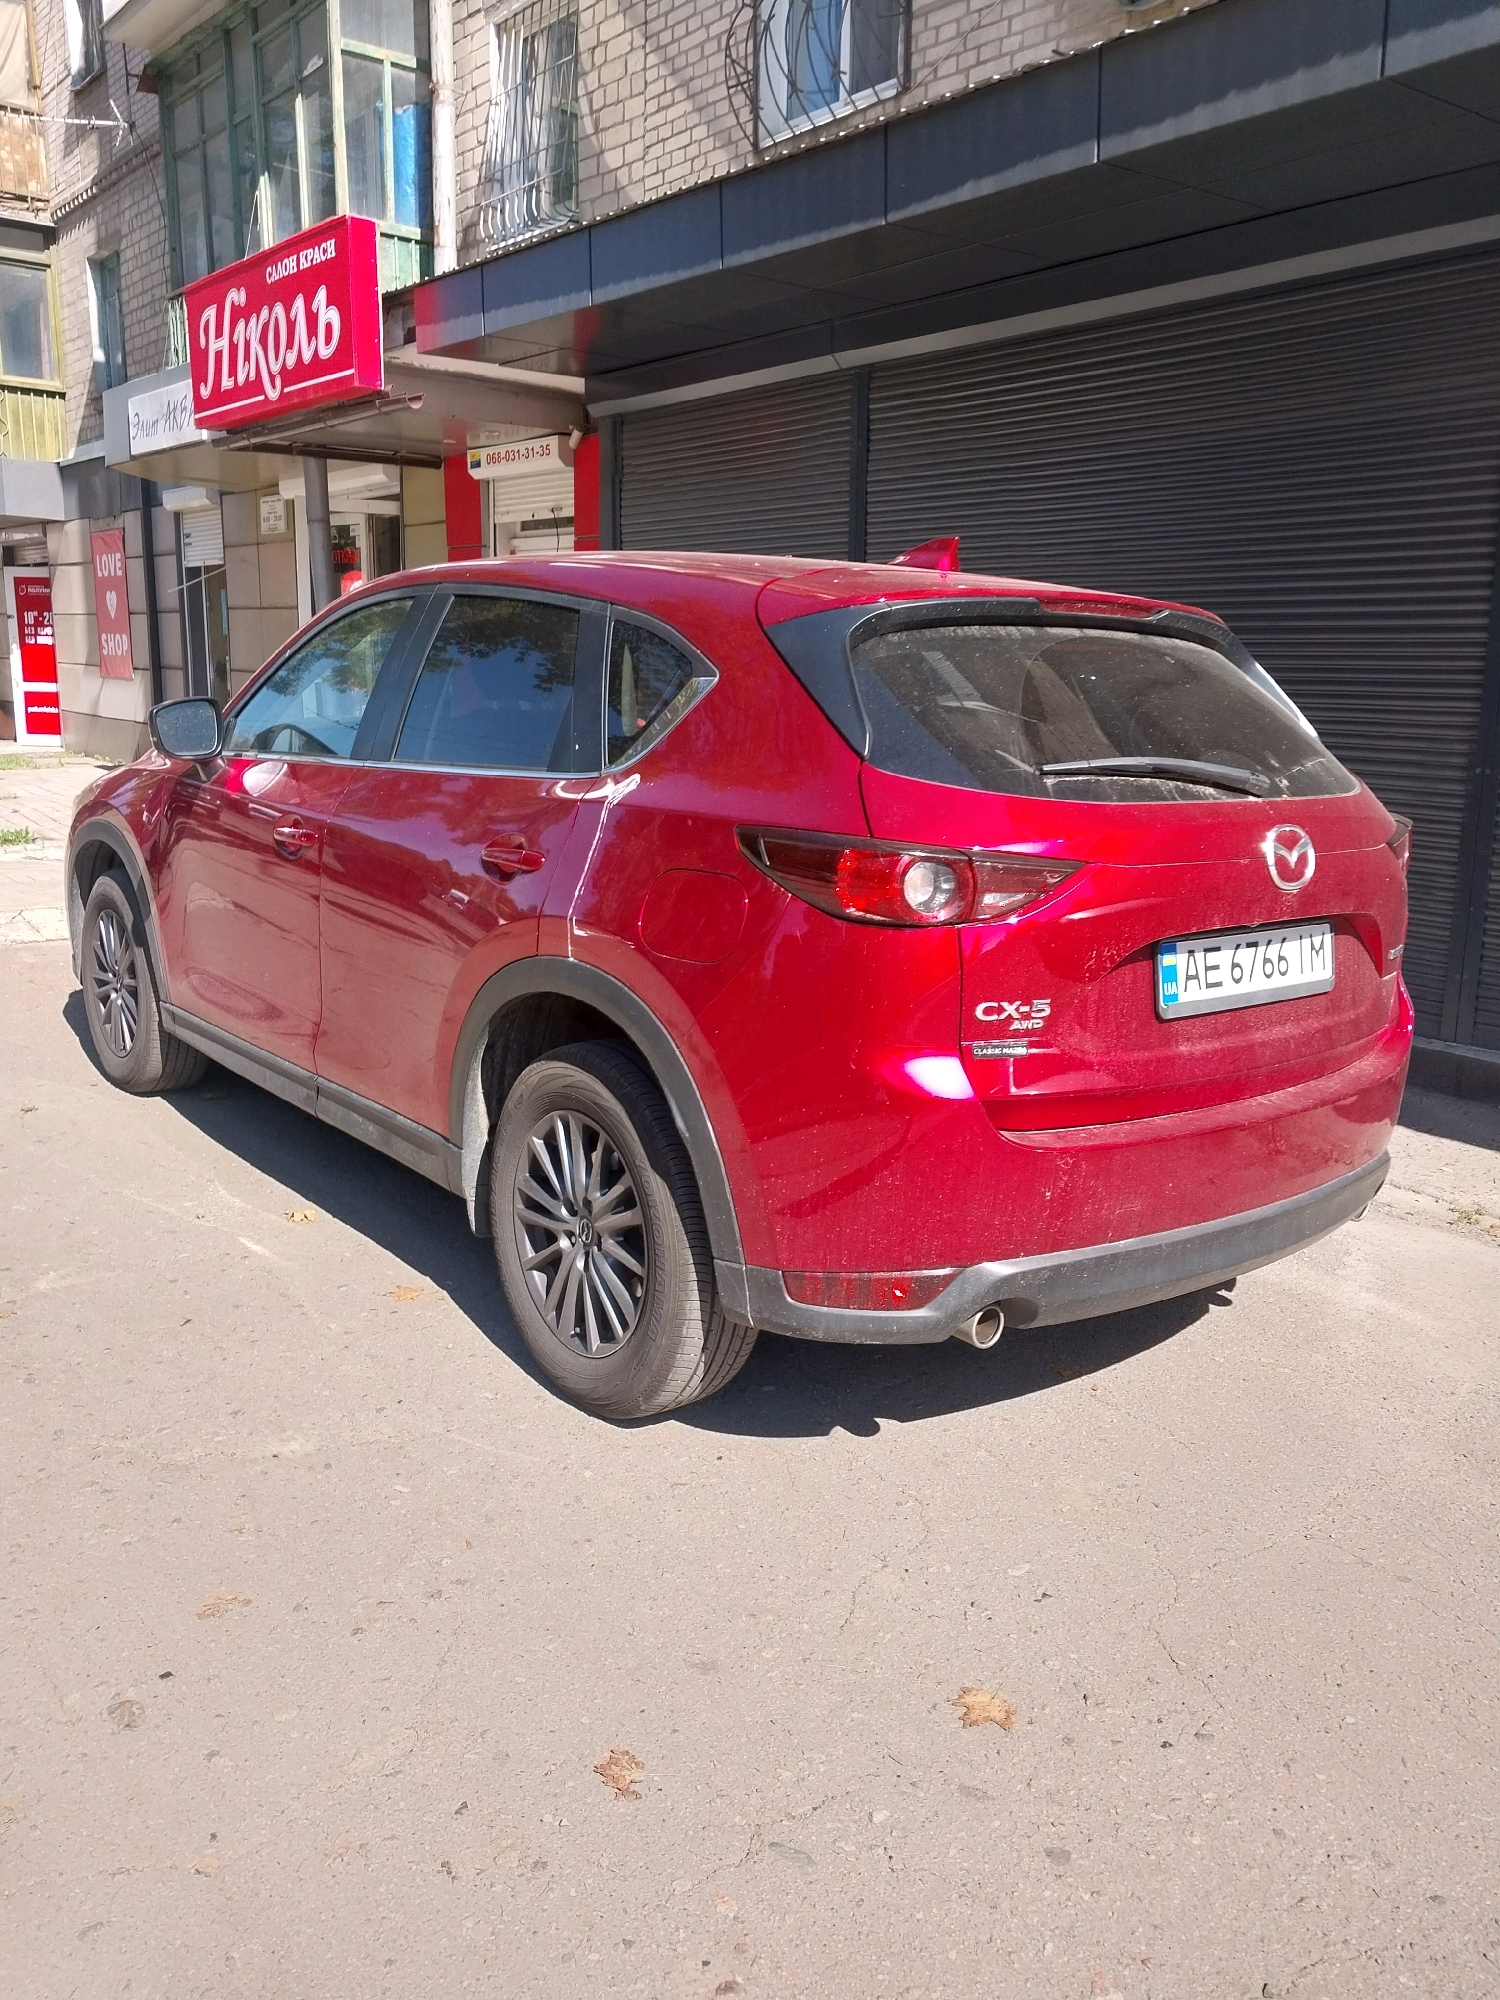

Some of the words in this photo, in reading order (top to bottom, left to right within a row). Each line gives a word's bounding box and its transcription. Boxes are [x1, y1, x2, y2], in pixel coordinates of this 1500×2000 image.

[265, 254, 298, 285] САЛОН
[299, 238, 337, 270] КРАСИ
[200, 284, 341, 401] Ніколь
[485, 443, 552, 466] 068-031-31-35
[96, 552, 123, 578] LOVE
[101, 632, 129, 657] SHOP
[1184, 946, 1223, 993] AE
[1230, 937, 1289, 985] 6766
[1298, 931, 1326, 975] IM
[1163, 981, 1179, 996] UA
[974, 999, 1051, 1022] CX-5
[1009, 1019, 1044, 1031] AWD
[634, 1150, 666, 1342] YOKOHAMA
